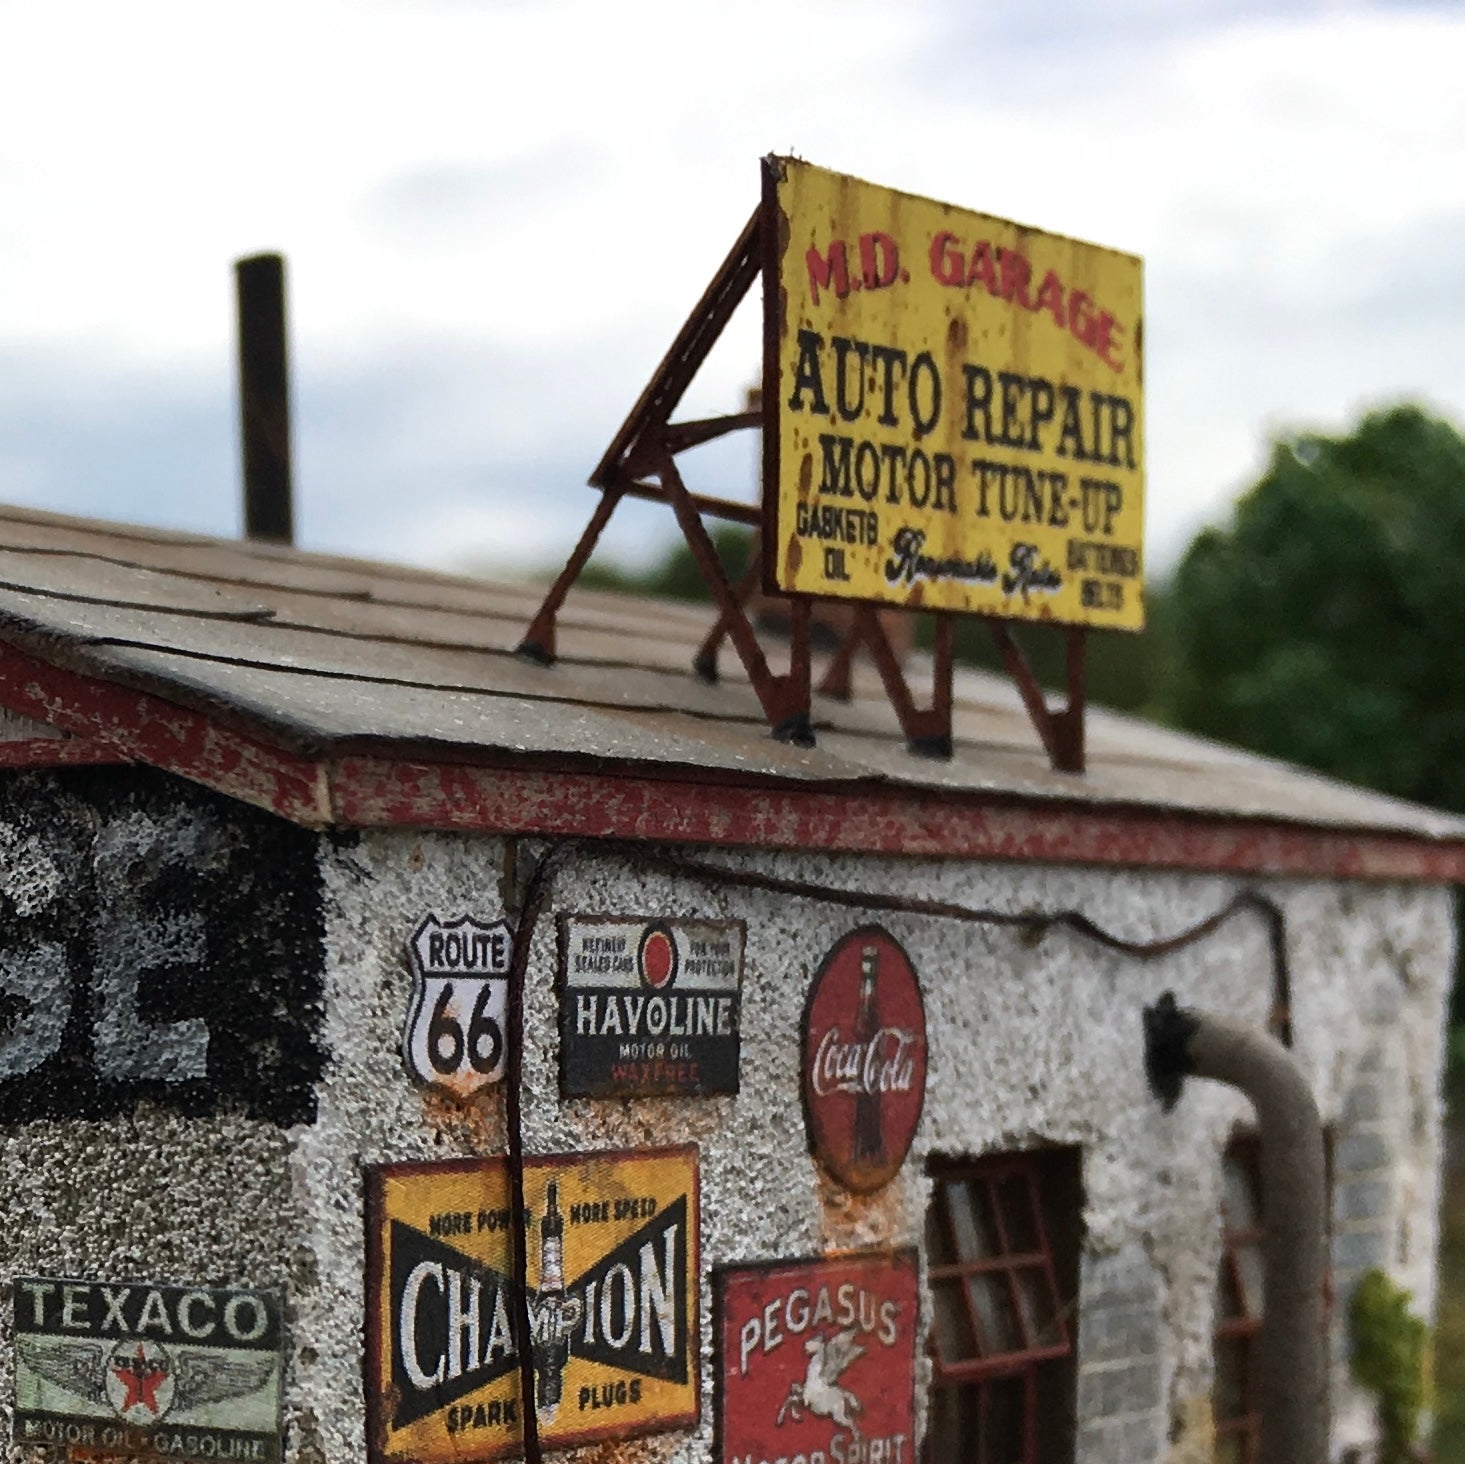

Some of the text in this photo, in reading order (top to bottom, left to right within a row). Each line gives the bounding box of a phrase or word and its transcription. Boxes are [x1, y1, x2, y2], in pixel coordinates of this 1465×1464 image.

[805, 230, 1126, 374] M.D. GARAGE
[788, 328, 1136, 470] AUTO REPAIR
[818, 433, 1123, 536] MOTOR TUNE-UP
[429, 931, 506, 970] ROUTE
[427, 982, 503, 1075] 66
[576, 994, 732, 1036] HAVOLINE
[619, 1042, 690, 1061] MOTOR OIL
[569, 1200, 610, 1226] MORE
[22, 1283, 268, 1341] TEXACO
[400, 1223, 678, 1390] CHAMPION
[741, 1283, 897, 1376] PEGASUS
[446, 1378, 642, 1434] SPARK PLUGS
[24, 1417, 266, 1460] MOTOR OIL GASOLINE
